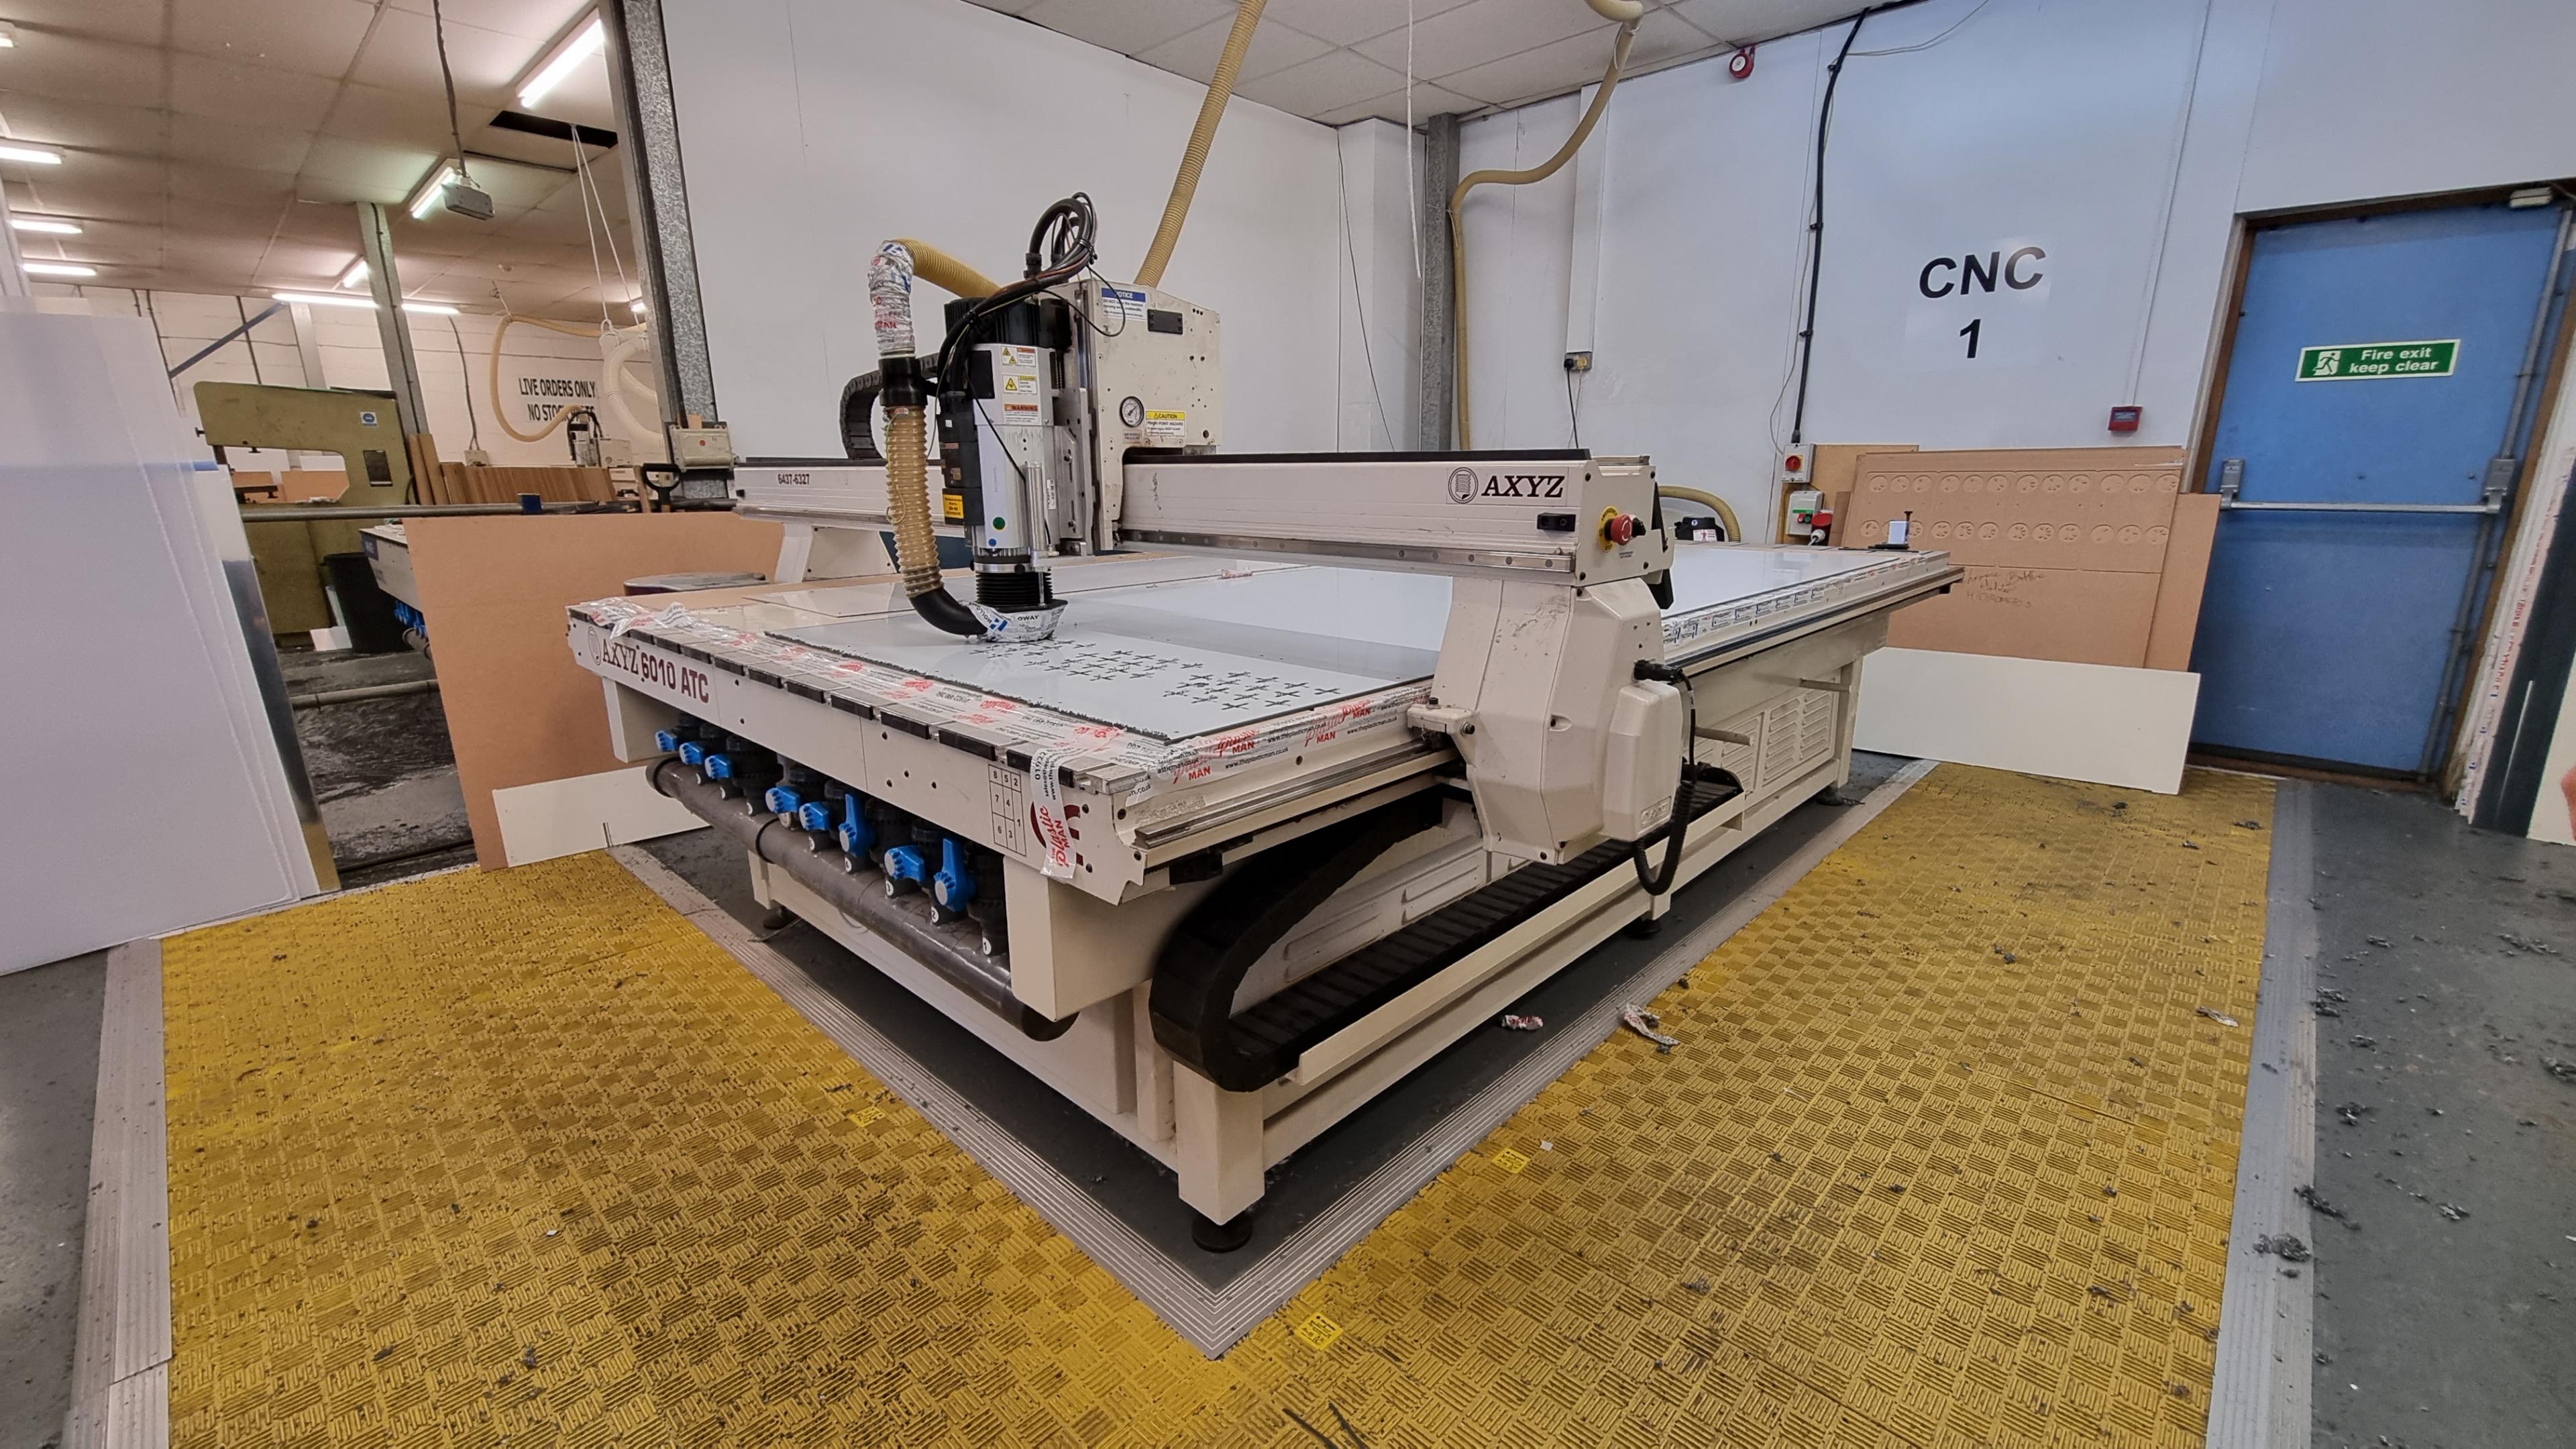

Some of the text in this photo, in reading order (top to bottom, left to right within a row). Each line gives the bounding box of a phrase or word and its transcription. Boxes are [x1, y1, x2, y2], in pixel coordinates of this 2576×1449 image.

[1919, 247, 2046, 299] CNC
[1960, 319, 1981, 358] 1
[2361, 347, 2432, 360] Fire exit
[2349, 360, 2438, 374] keep clear
[519, 378, 595, 398] LIVE ORDERS ONLY
[527, 404, 541, 421] NO
[777, 474, 810, 485] 6437-6327
[1481, 476, 1565, 498] AXYZ
[603, 638, 709, 704] AXYZ 6010 ATC
[1352, 708, 1372, 720] MAN
[1347, 716, 1397, 735] www.theplasticman.co.uk
[1317, 731, 1336, 744] MAN
[1232, 740, 1255, 754] MAN
[1225, 747, 1289, 769] www.theplasticman.co.uk
[993, 770, 1018, 786] 8 5 2
[1188, 766, 1211, 780] MAN
[995, 794, 1010, 807] 7 4
[1017, 818, 1020, 827] 1
[998, 826, 1013, 839] 6 3
[1055, 820, 1070, 849] MAN
[931, 910, 936, 919] 2
[983, 942, 987, 951] 1
